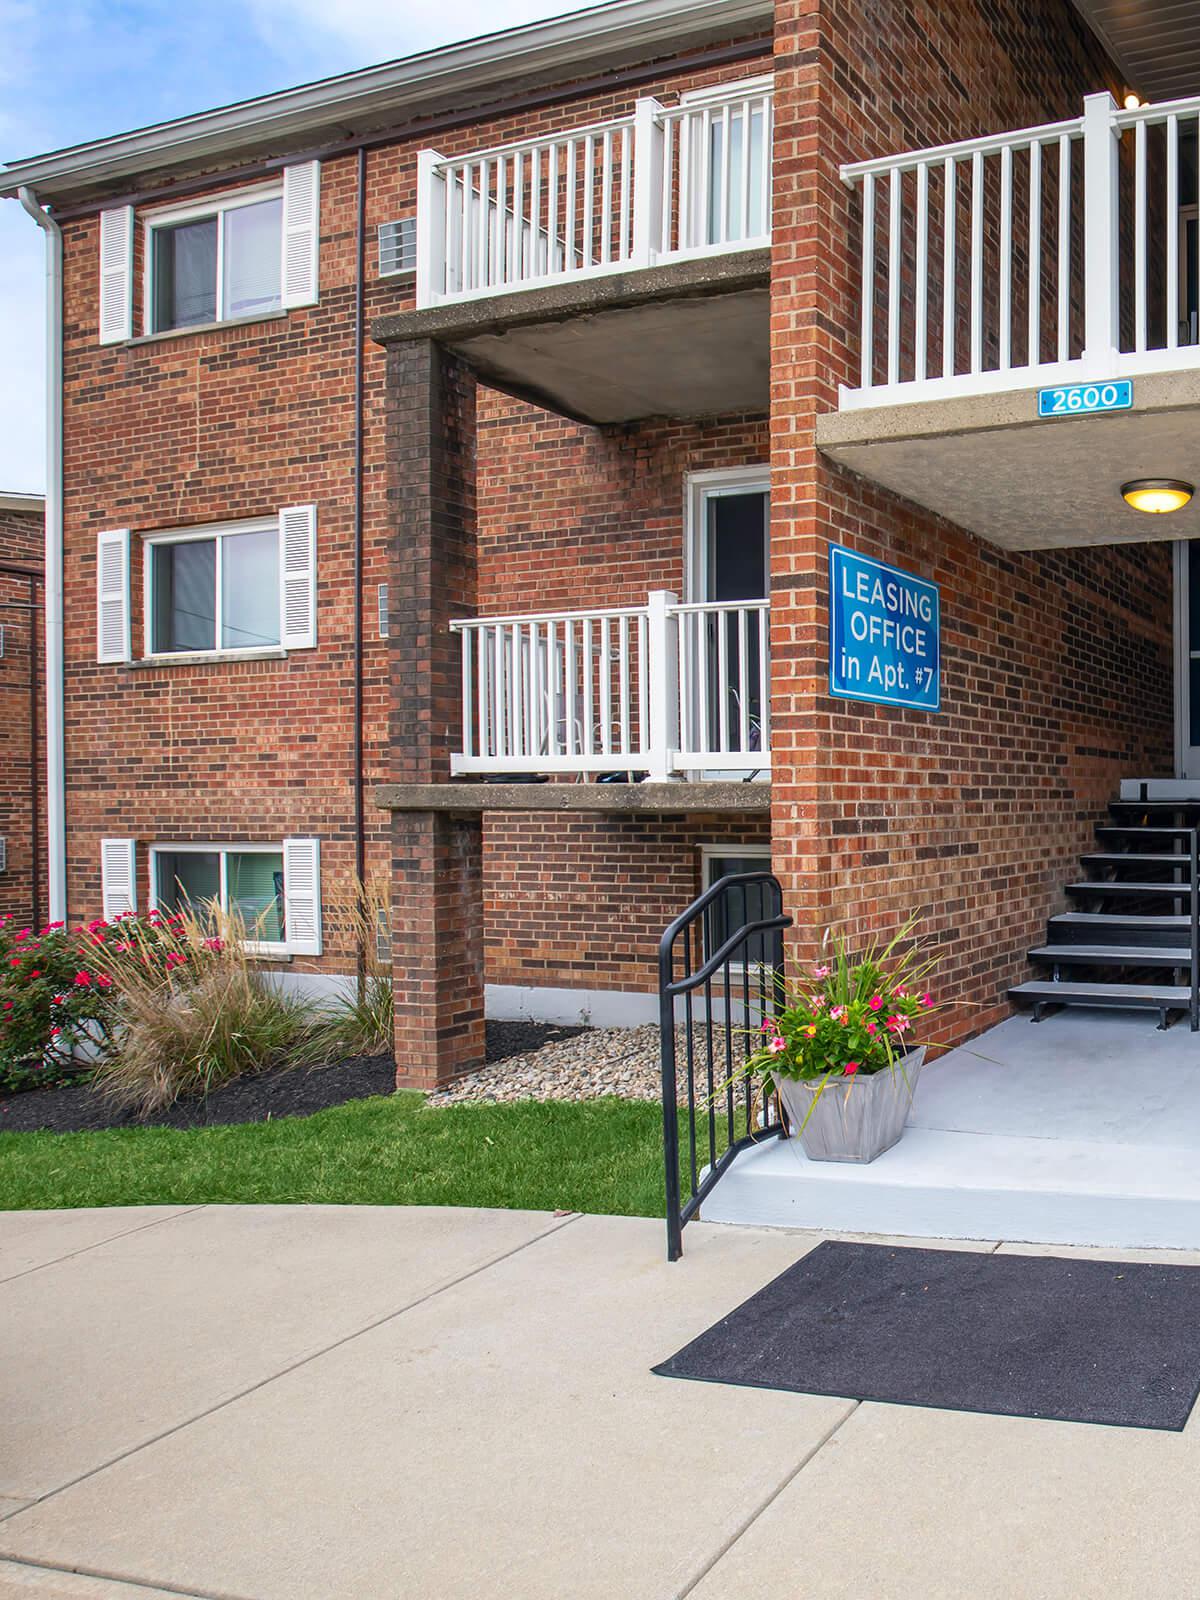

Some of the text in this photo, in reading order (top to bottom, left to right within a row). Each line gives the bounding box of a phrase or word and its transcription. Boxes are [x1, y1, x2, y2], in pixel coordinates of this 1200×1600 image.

[1052, 385, 1118, 411] 2600
[842, 566, 932, 623] LEASING
[850, 610, 926, 657] OFFICE
[841, 647, 933, 693] in Apt. #7
